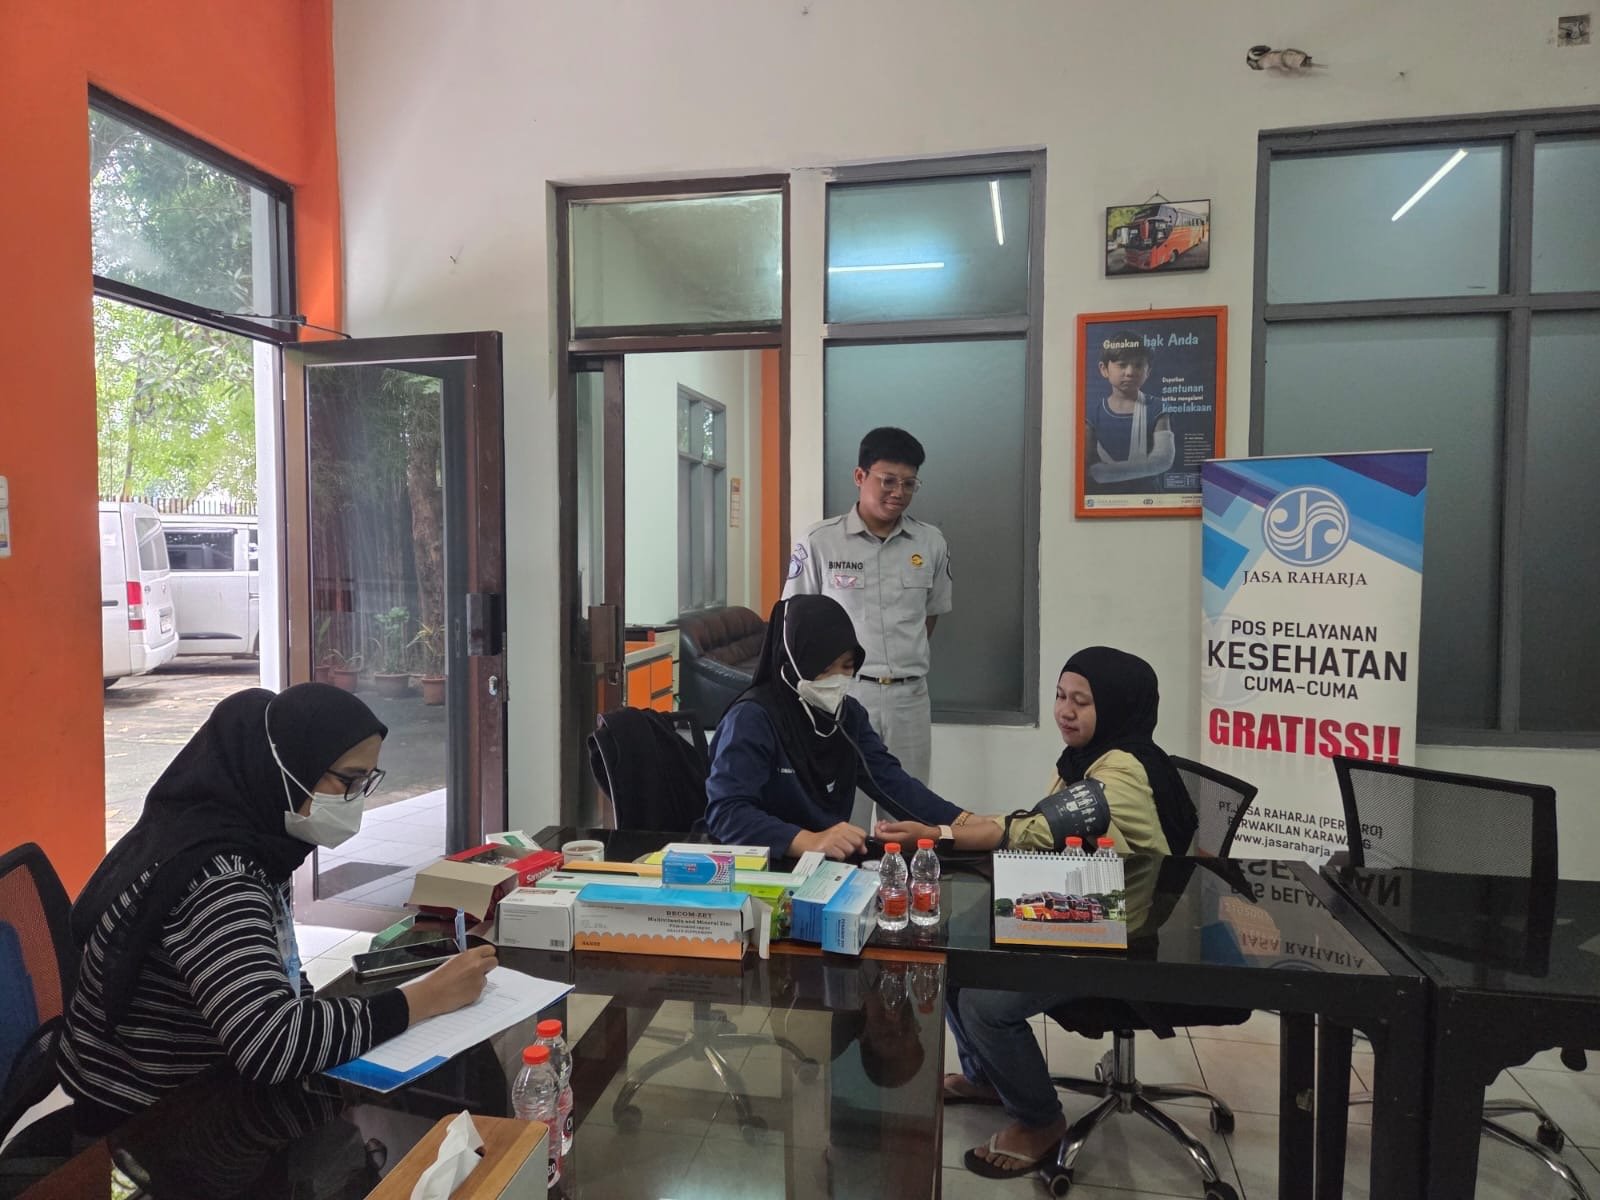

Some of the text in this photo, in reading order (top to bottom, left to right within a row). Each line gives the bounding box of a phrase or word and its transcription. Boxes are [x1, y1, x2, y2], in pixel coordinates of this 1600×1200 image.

[1103, 340, 1140, 350] Gunakan
[1168, 332, 1199, 346] Anda
[1161, 384, 1204, 394] santunan
[828, 560, 864, 570] BINTANG
[1242, 570, 1368, 588] JASA RAHARJA
[1231, 620, 1378, 642] POS PELAYANAN
[1208, 639, 1408, 682] KESEHATAN
[1244, 676, 1359, 700] CUMA-CUMA
[1209, 708, 1401, 765] GRATISS!!
[1227, 815, 1372, 850] PRWAKILAN KARAWG
[1264, 807, 1316, 825] RAHARJA
[1319, 816, 1384, 839] (PERRO)
